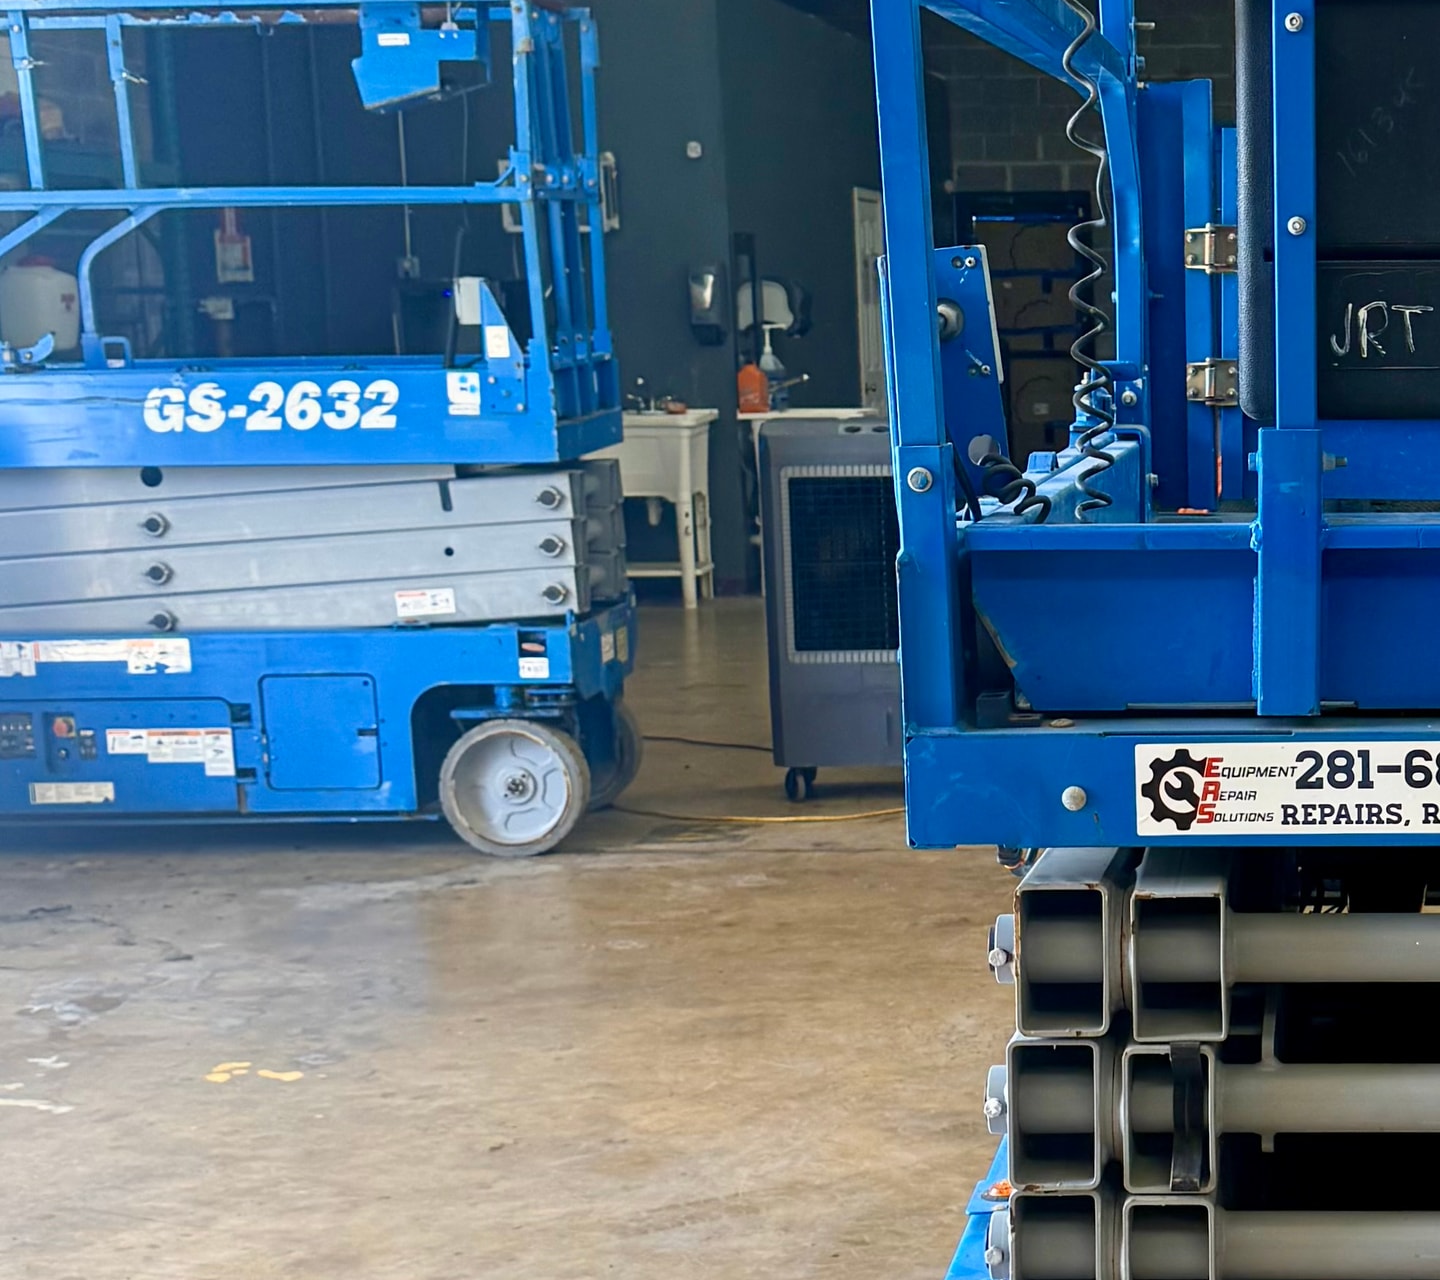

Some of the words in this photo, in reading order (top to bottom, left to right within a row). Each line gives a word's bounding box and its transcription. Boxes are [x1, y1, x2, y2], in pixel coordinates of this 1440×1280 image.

[1330, 300, 1434, 358] JRT
[143, 379, 400, 433] GS-2632
[1281, 803, 1411, 827] REPAIRS,
